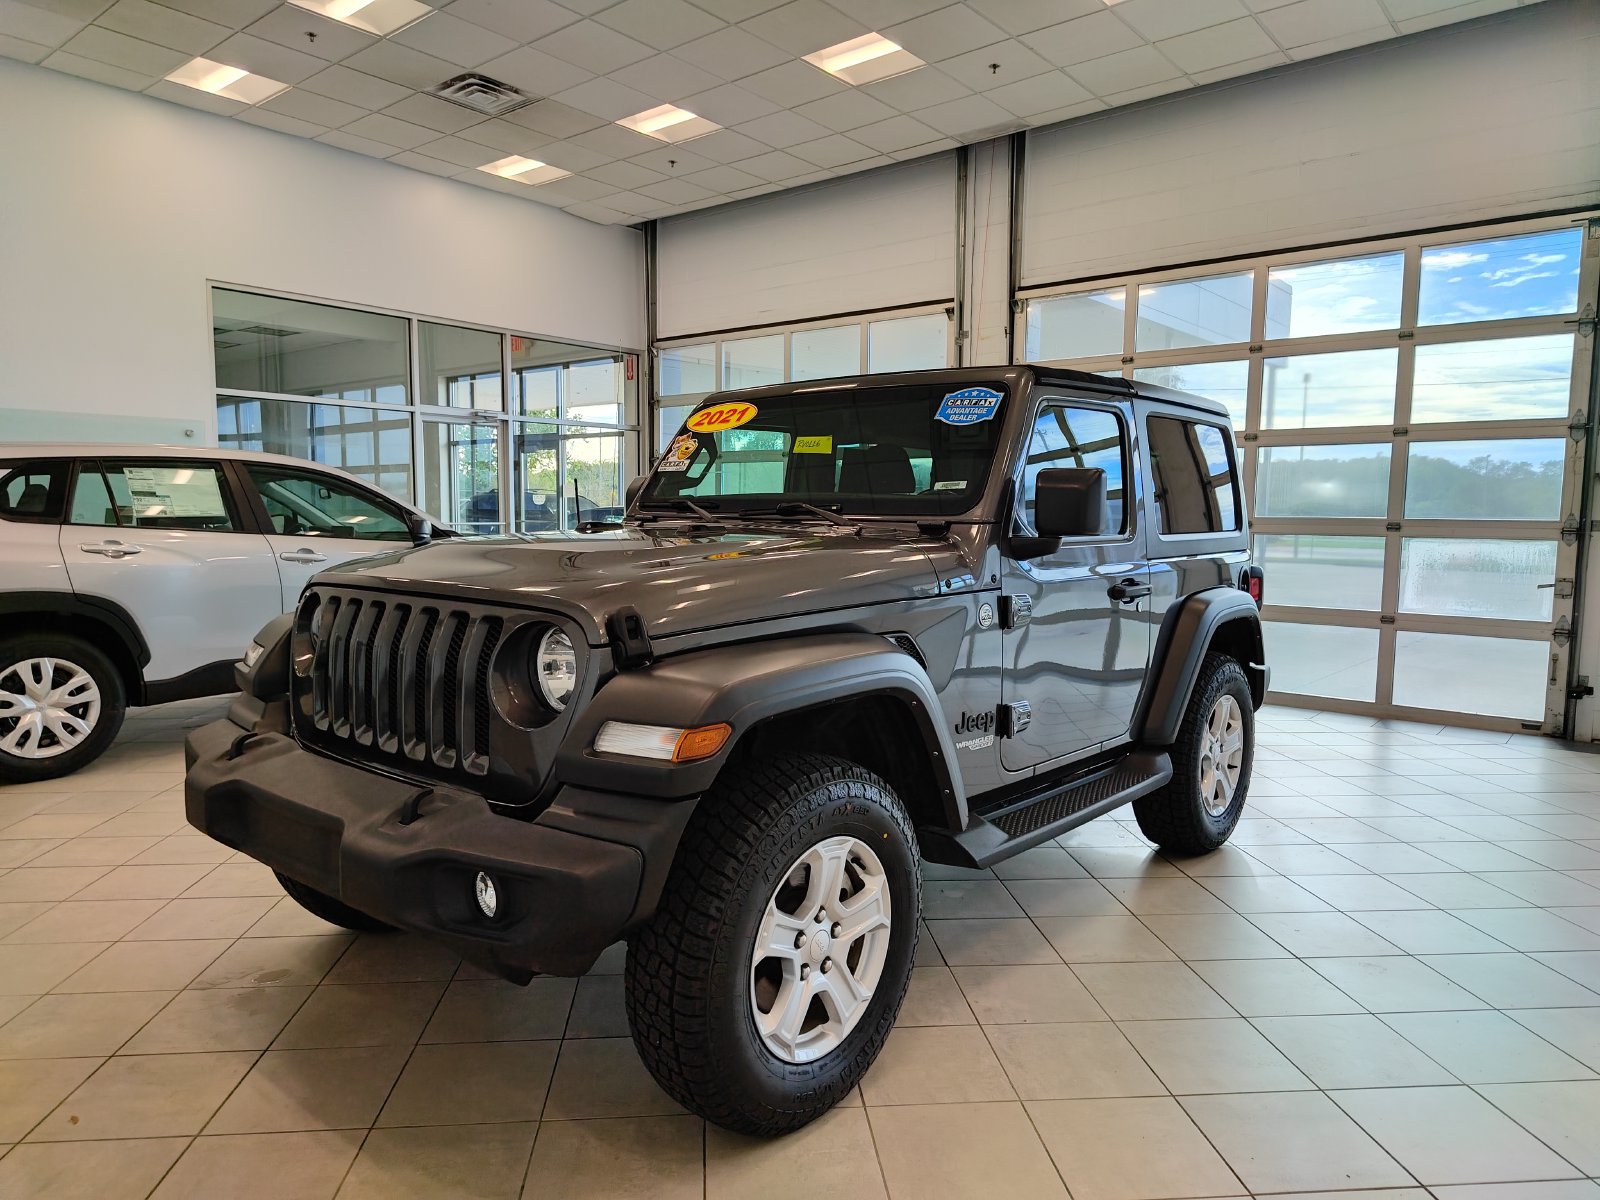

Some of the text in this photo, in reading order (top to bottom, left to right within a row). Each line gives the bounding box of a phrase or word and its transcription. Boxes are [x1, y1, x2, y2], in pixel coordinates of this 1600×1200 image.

[947, 398, 994, 407] CARFAX
[692, 406, 751, 427] 2021
[955, 710, 995, 735] Jeep
